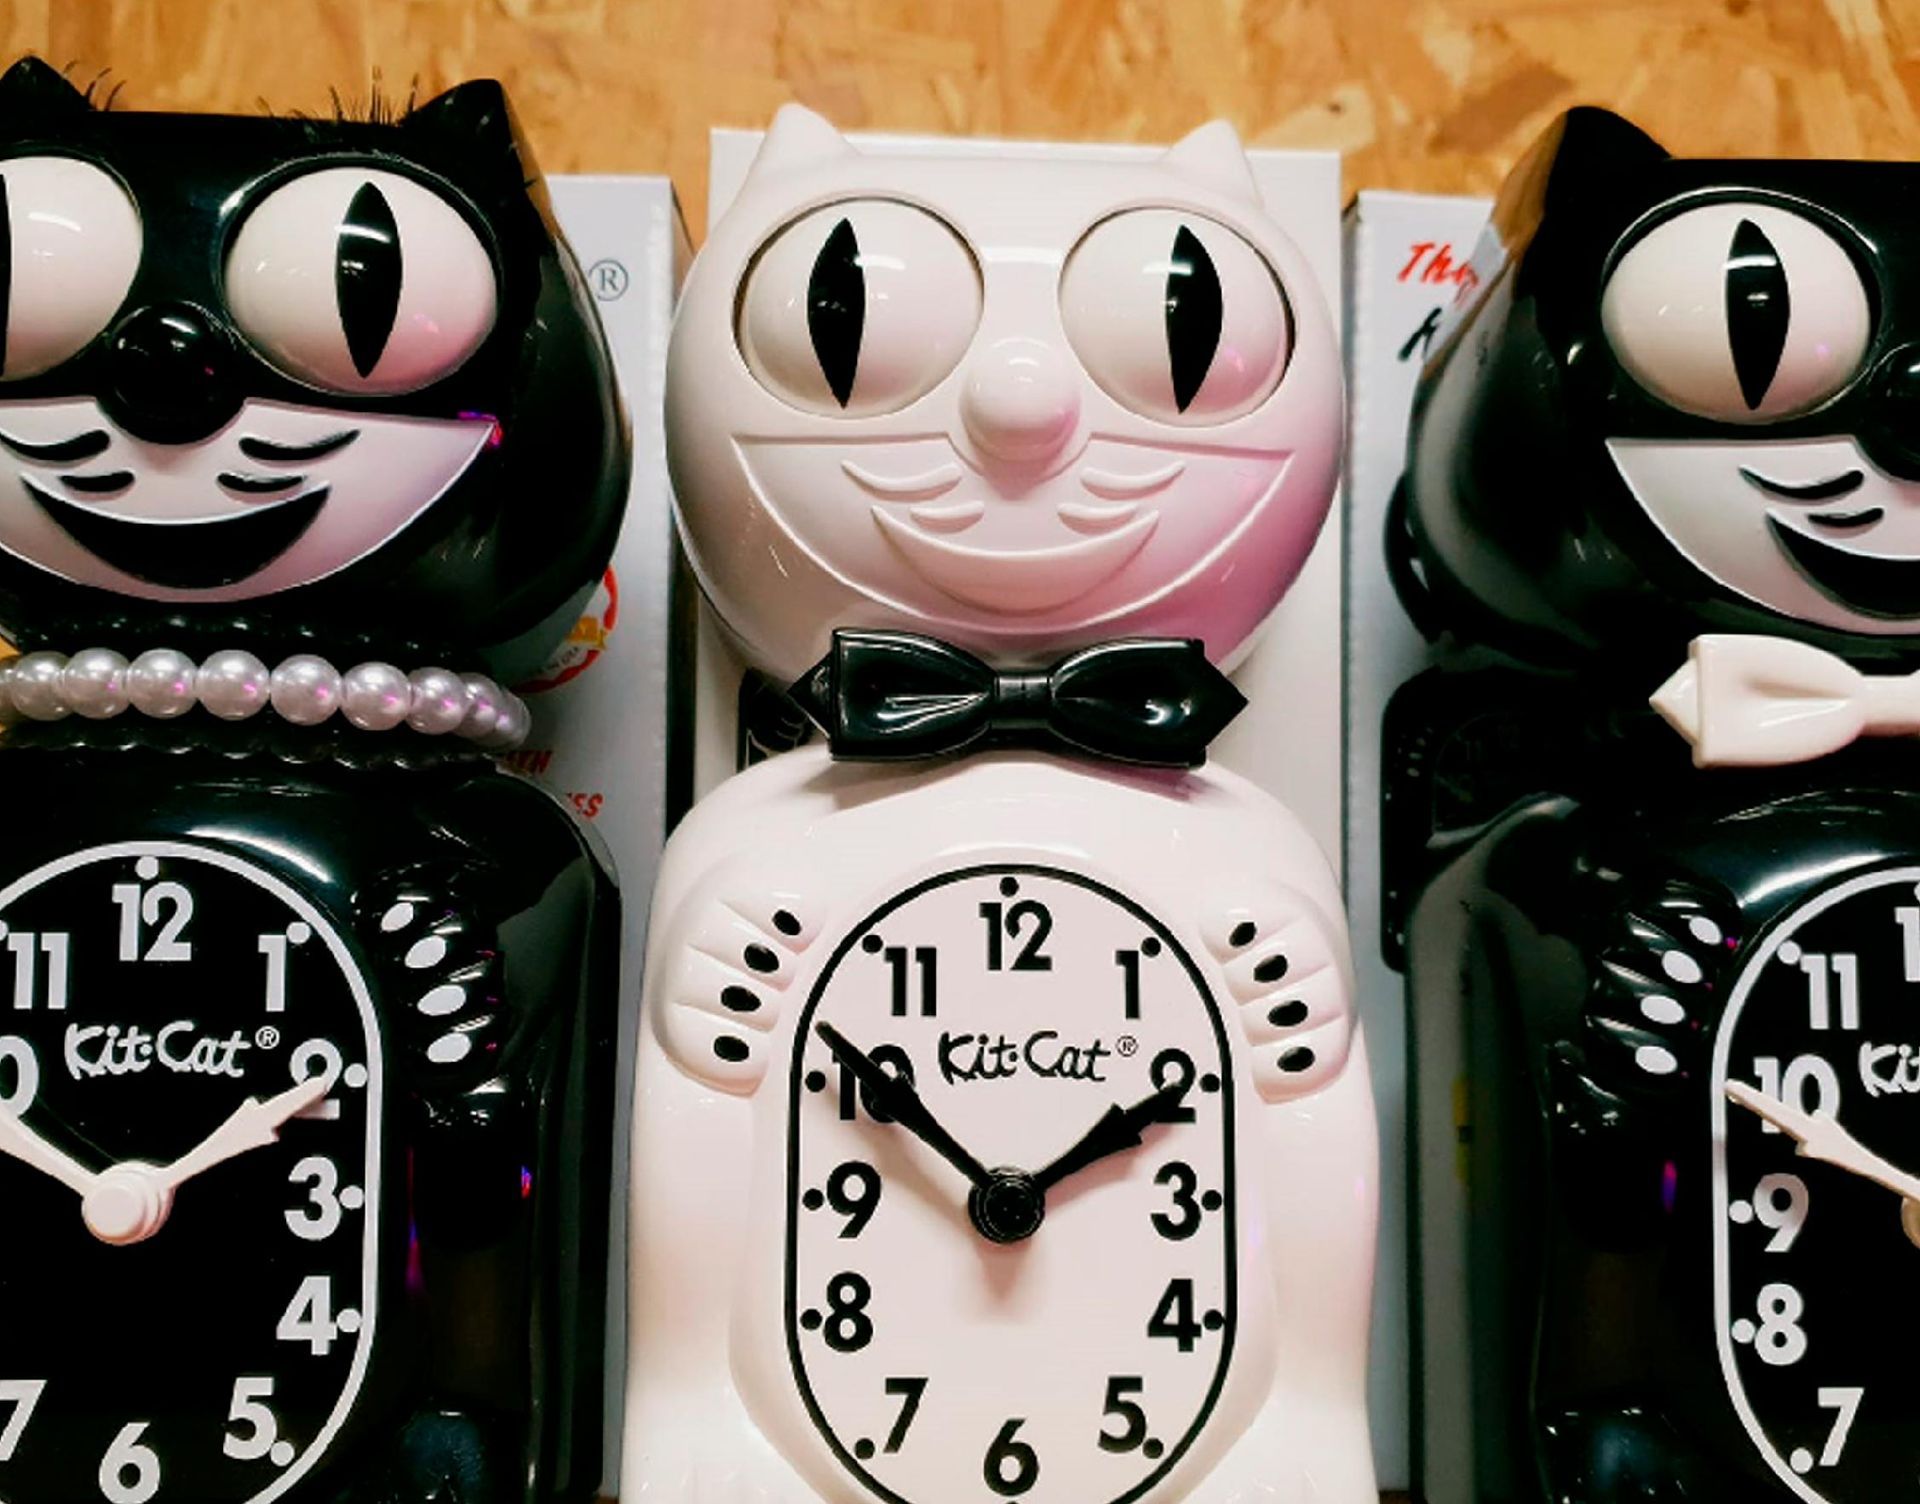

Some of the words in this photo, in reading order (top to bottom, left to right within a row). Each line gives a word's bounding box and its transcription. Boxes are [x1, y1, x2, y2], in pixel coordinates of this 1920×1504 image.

[111, 881, 194, 962] 12
[979, 899, 1054, 971] 12
[1895, 906, 1920, 982] 1
[7, 932, 69, 1010] 11
[258, 933, 287, 1012] 1
[884, 947, 937, 1017] 11
[1116, 950, 1140, 1019] 1
[1800, 953, 1859, 1030] 11
[0, 1036, 39, 1120] 0
[290, 1039, 343, 1120] 2
[832, 1044, 914, 1123] 10
[1150, 1048, 1196, 1123] 2
[1753, 1053, 1841, 1134] 10
[284, 1156, 342, 1241] 3
[826, 1160, 882, 1239] 9
[1151, 1161, 1202, 1241] 3
[1753, 1173, 1809, 1253] 9
[276, 1275, 338, 1356] 4
[823, 1271, 874, 1353] 8
[1147, 1278, 1203, 1353] 4
[1754, 1283, 1807, 1366] 8
[0, 1379, 47, 1462] 7
[222, 1376, 278, 1461] 5
[884, 1377, 930, 1454] 7
[1098, 1376, 1148, 1453] 5
[1817, 1386, 1865, 1467] 7
[98, 1422, 161, 1504] 6
[983, 1419, 1040, 1497] 6
